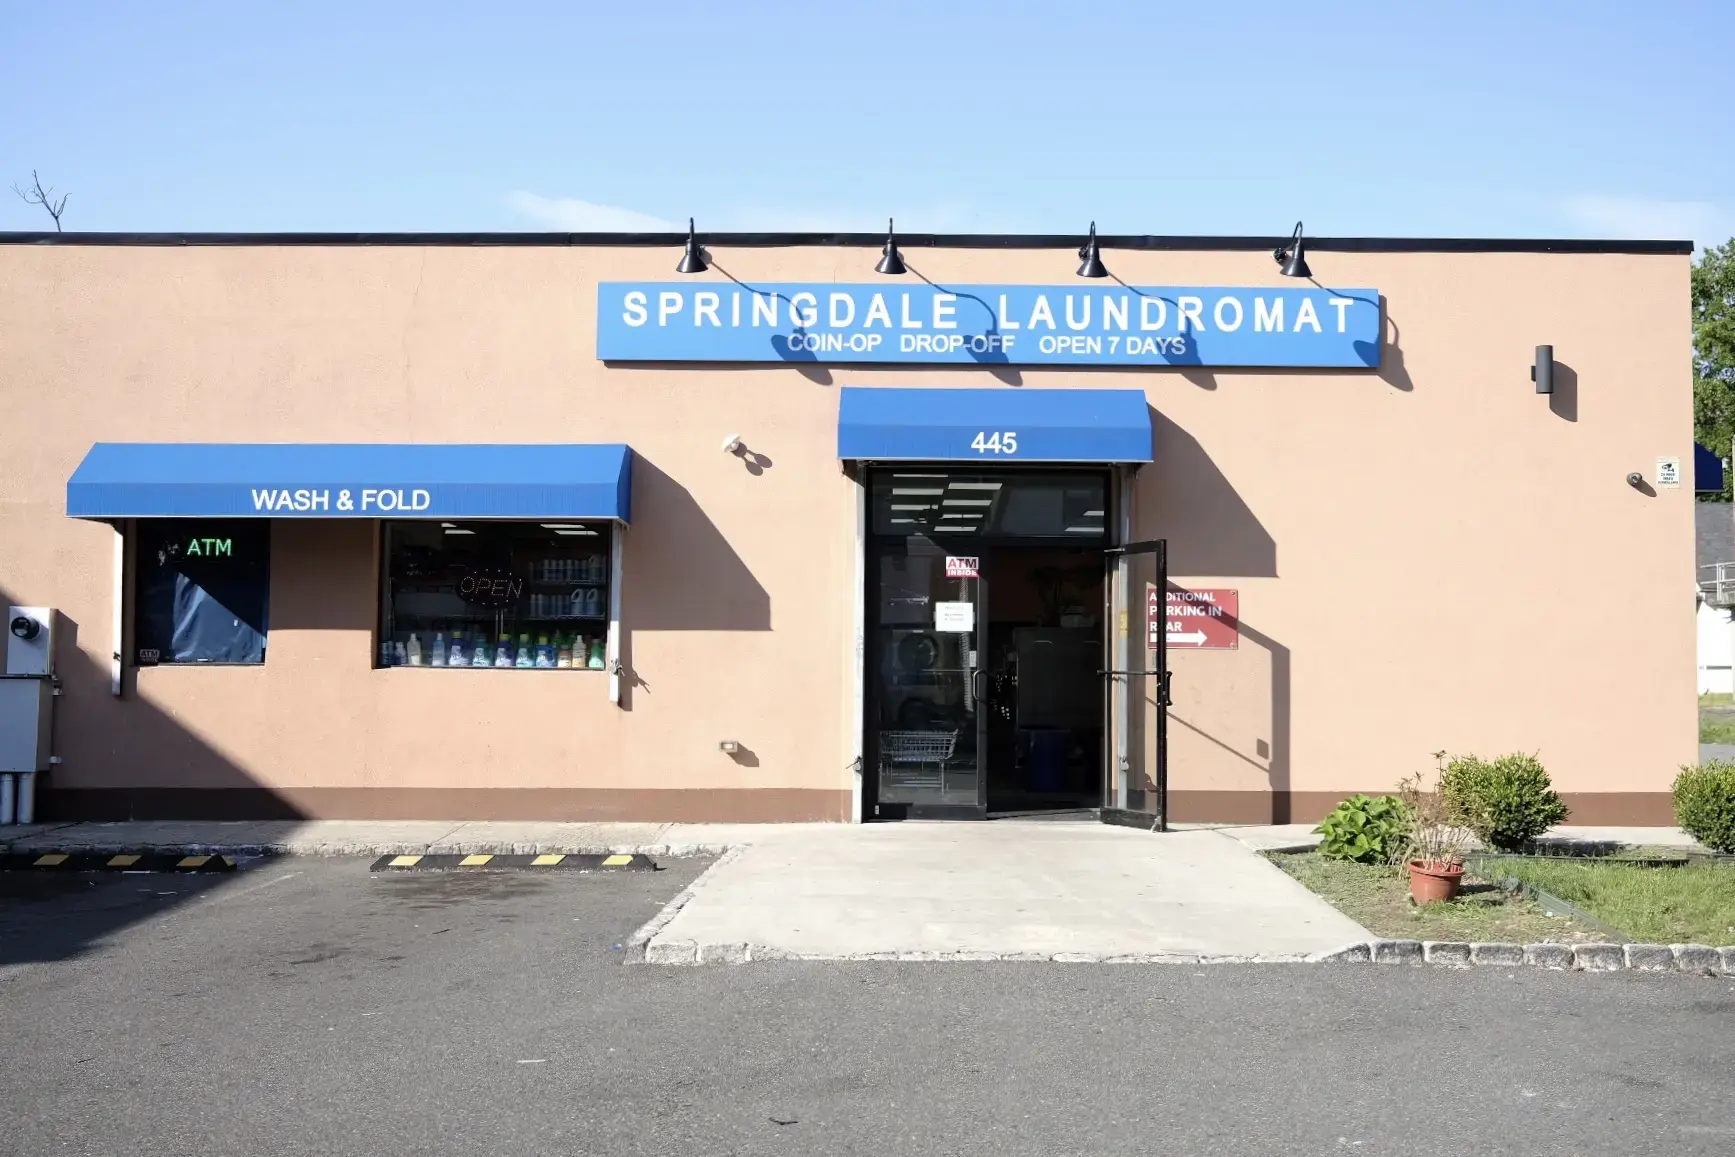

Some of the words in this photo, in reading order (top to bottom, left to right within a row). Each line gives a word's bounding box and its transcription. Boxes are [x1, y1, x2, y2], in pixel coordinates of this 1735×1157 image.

[623, 291, 957, 328] SPRINGDALE
[999, 294, 1354, 333] LAUNDROMAT
[787, 333, 882, 352] COIN-OP
[899, 334, 1015, 353] DROP-OFF
[1039, 335, 1102, 354] OPEN
[1108, 336, 1120, 354] 7
[1126, 336, 1187, 355] DAYS
[970, 431, 1017, 454] 445
[252, 489, 329, 511] WASH
[336, 489, 354, 511] &
[361, 489, 431, 511] FOLD
[187, 538, 232, 557] ATM
[948, 558, 977, 568] ATM
[460, 576, 523, 599] OPEN
[1149, 592, 1215, 601] ADITIONAL
[1149, 606, 1206, 616] PRKING
[1208, 606, 1222, 616] IN
[1149, 621, 1182, 631] RAR
